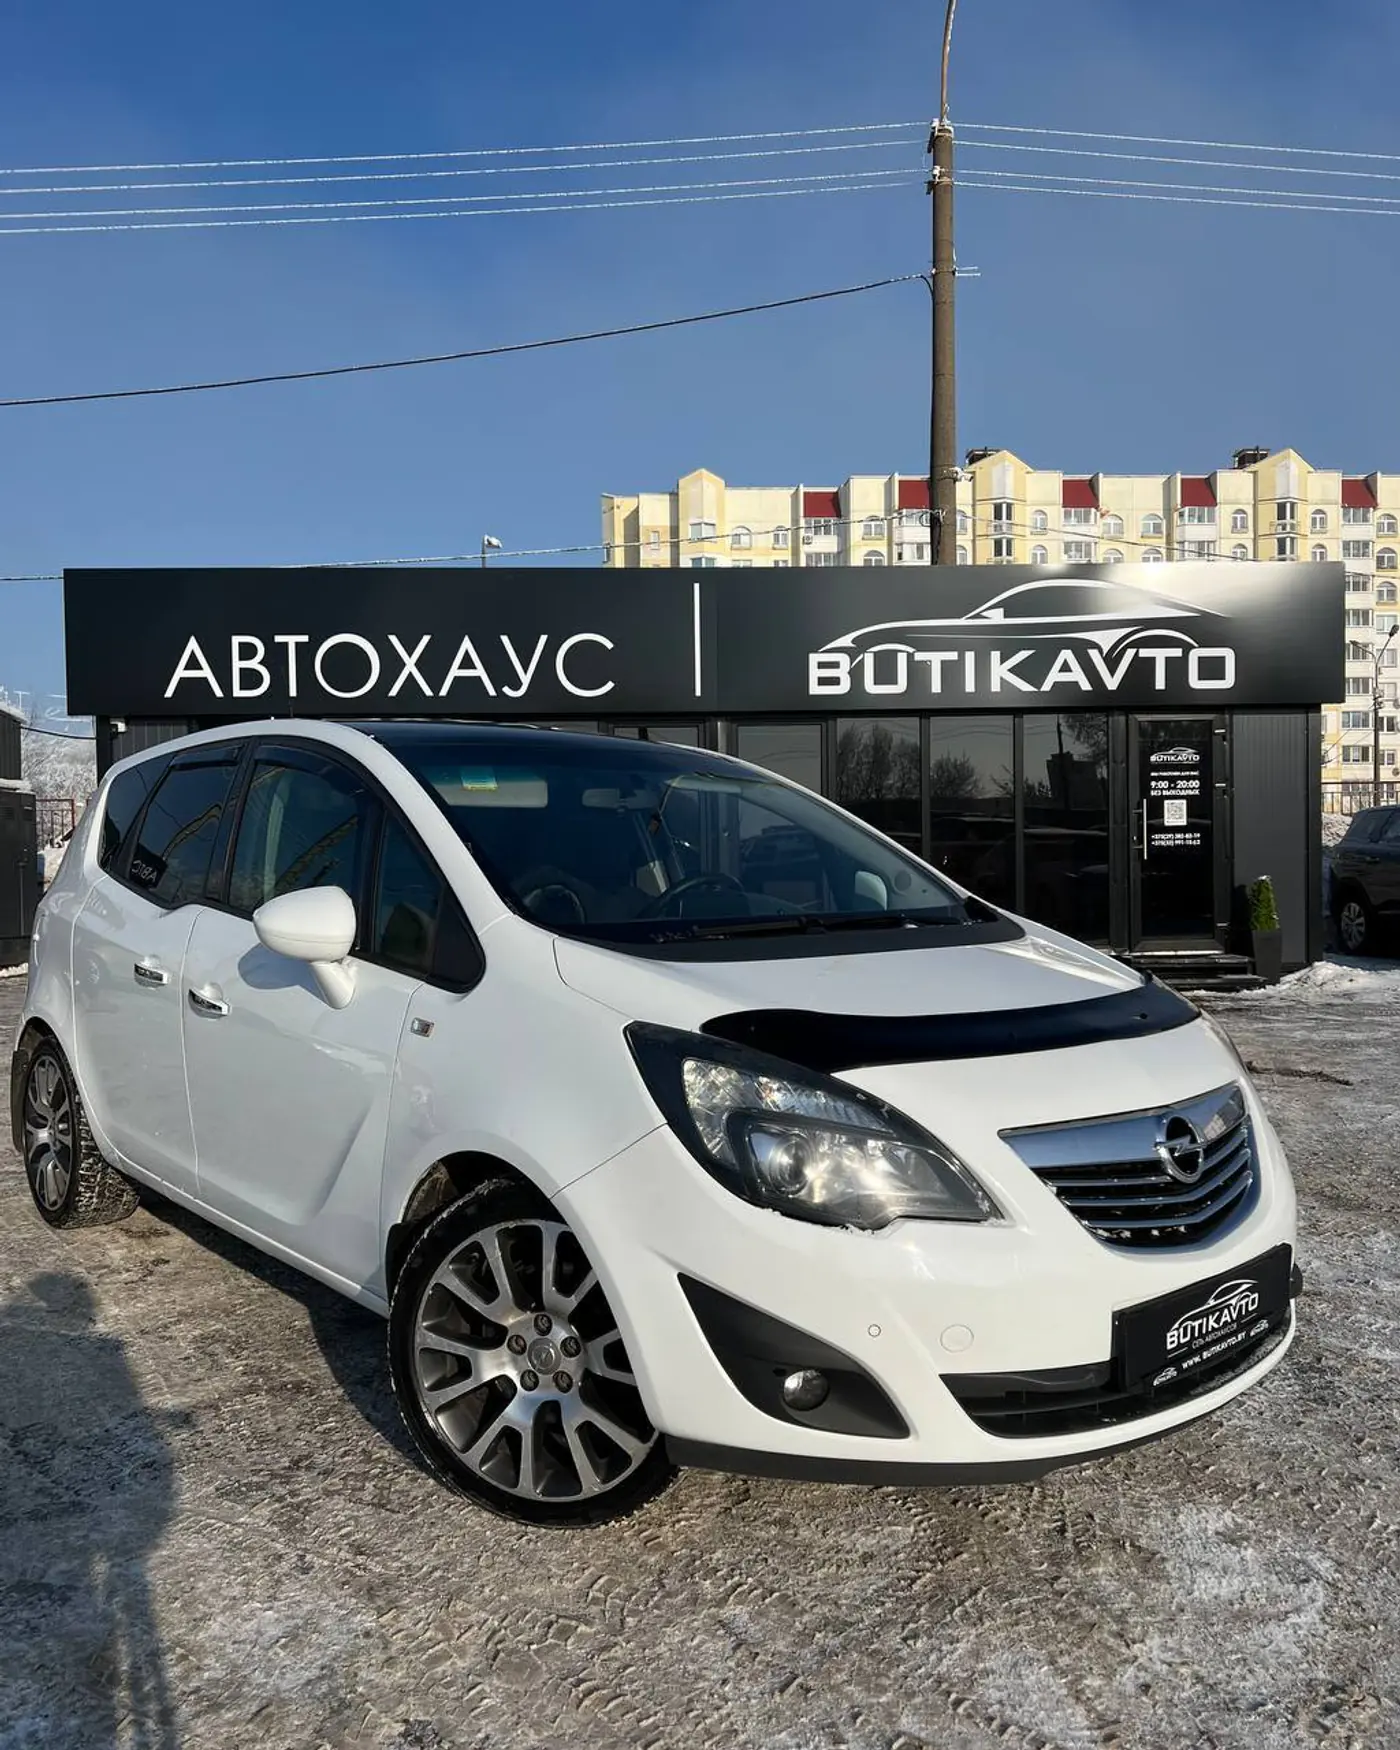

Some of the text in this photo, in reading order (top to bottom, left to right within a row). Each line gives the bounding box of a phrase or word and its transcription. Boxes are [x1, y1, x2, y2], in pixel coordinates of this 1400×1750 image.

[164, 633, 614, 698] АВТОХАУС
[808, 646, 1235, 695] BUTIKAVTO
[1150, 754, 1200, 762] BUTIKAVTO
[1150, 780, 1169, 789] 9:00
[1176, 780, 1200, 788] 20:00
[1166, 1292, 1259, 1350] BUTIKAVTO
